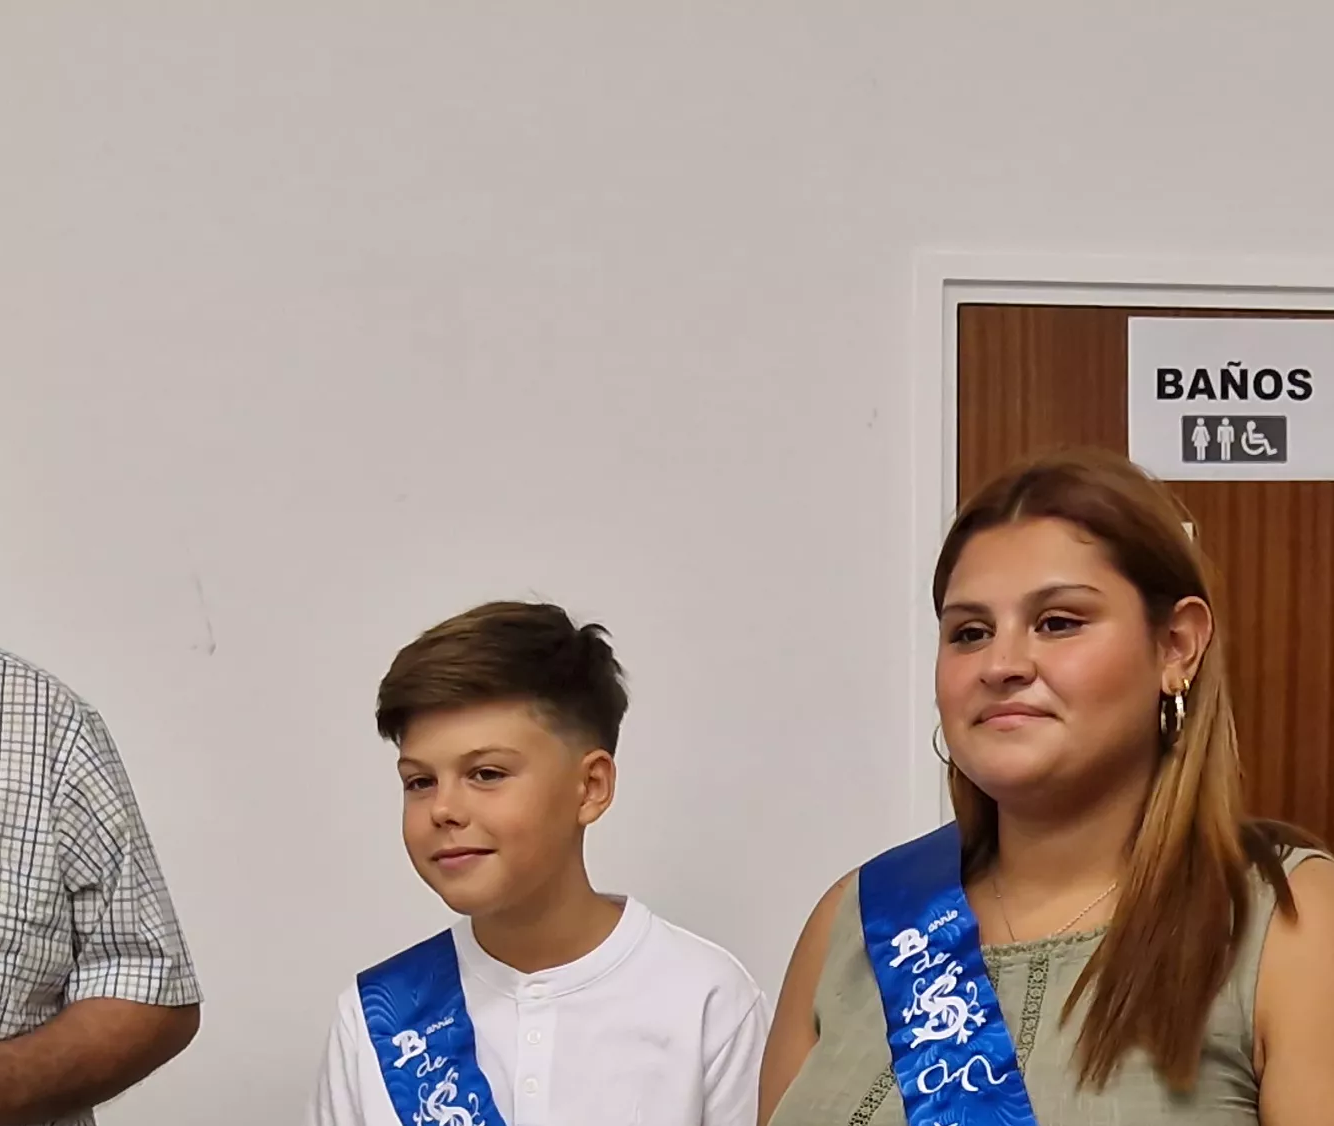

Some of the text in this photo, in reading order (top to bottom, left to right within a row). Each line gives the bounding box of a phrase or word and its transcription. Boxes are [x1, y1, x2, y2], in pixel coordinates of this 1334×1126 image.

[1157, 361, 1313, 401] BAÑOS
[912, 951, 951, 974] de
[417, 1052, 448, 1078] de
